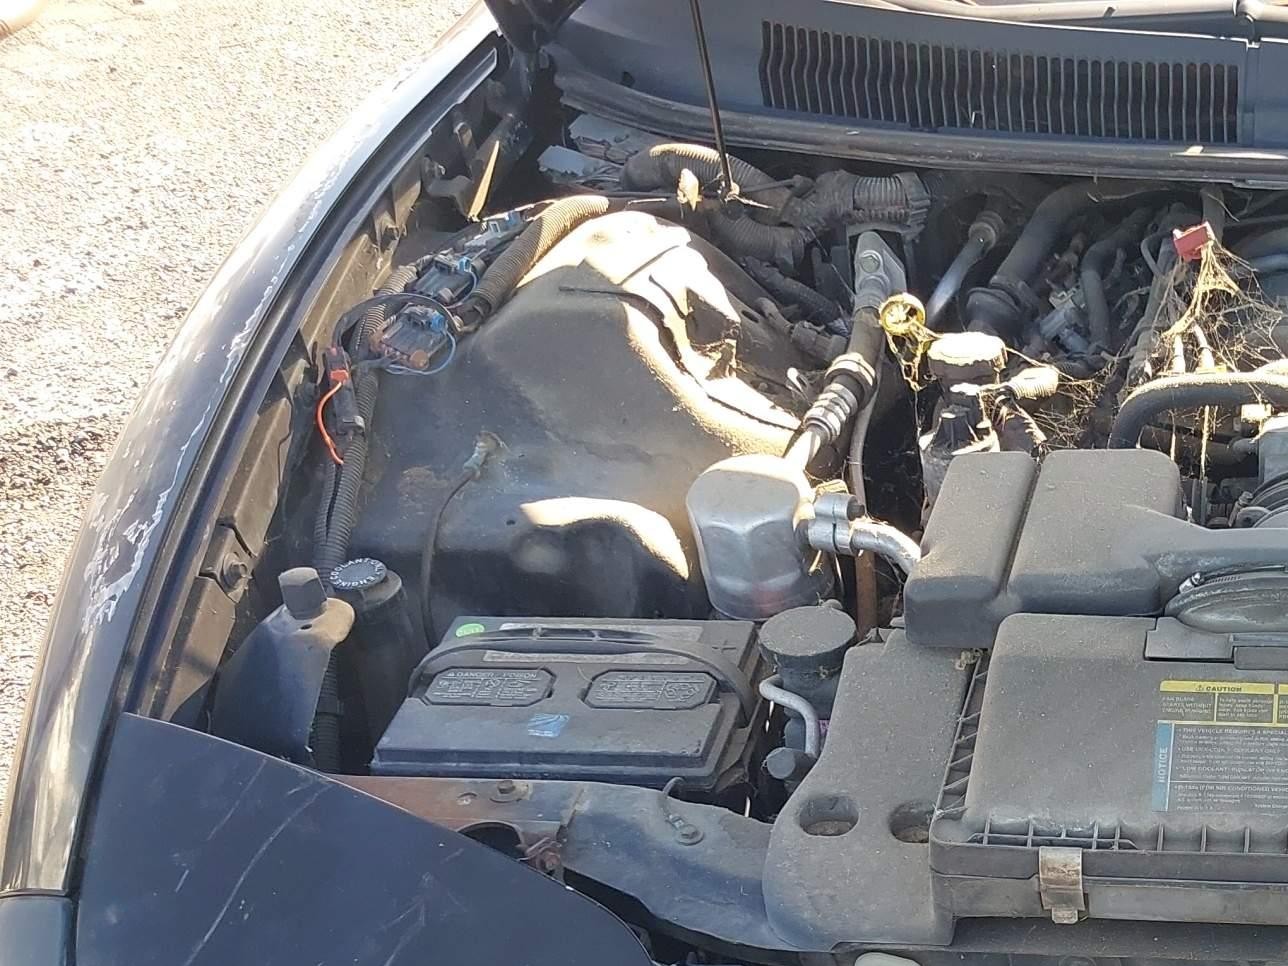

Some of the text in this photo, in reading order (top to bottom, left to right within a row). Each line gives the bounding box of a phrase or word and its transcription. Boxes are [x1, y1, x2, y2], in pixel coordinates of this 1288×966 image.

[329, 557, 370, 580] COOLANT
[1205, 685, 1243, 693] CAUTION
[1157, 746, 1168, 783] NOTICE
